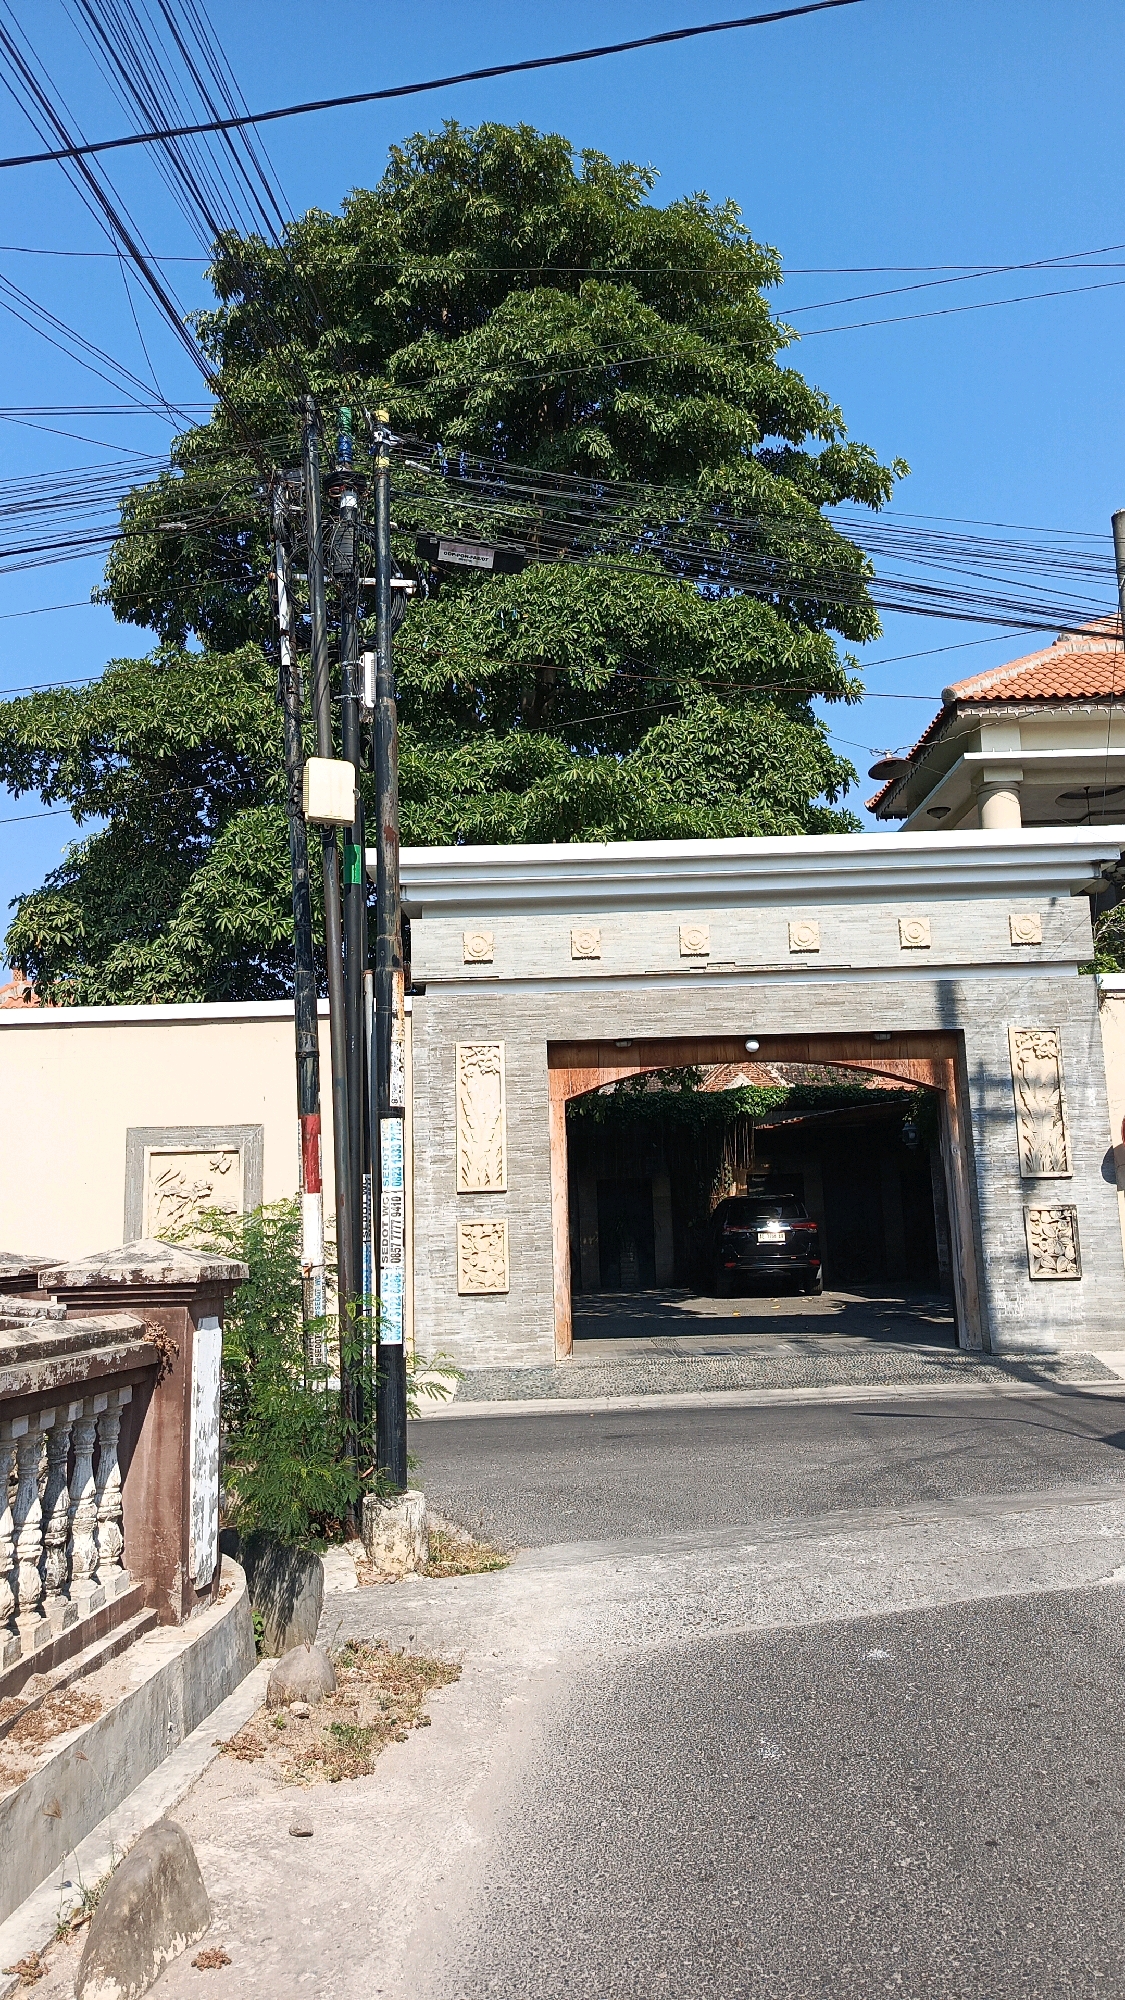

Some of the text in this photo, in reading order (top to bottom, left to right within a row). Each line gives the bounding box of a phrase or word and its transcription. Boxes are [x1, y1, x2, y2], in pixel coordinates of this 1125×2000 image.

[391, 1144, 402, 1164] 1333
[391, 1166, 402, 1187] 0823
[382, 1197, 389, 1216] WC
[390, 1196, 402, 1264] 0857 7777 9410
[314, 1334, 322, 1358] SEDOT
